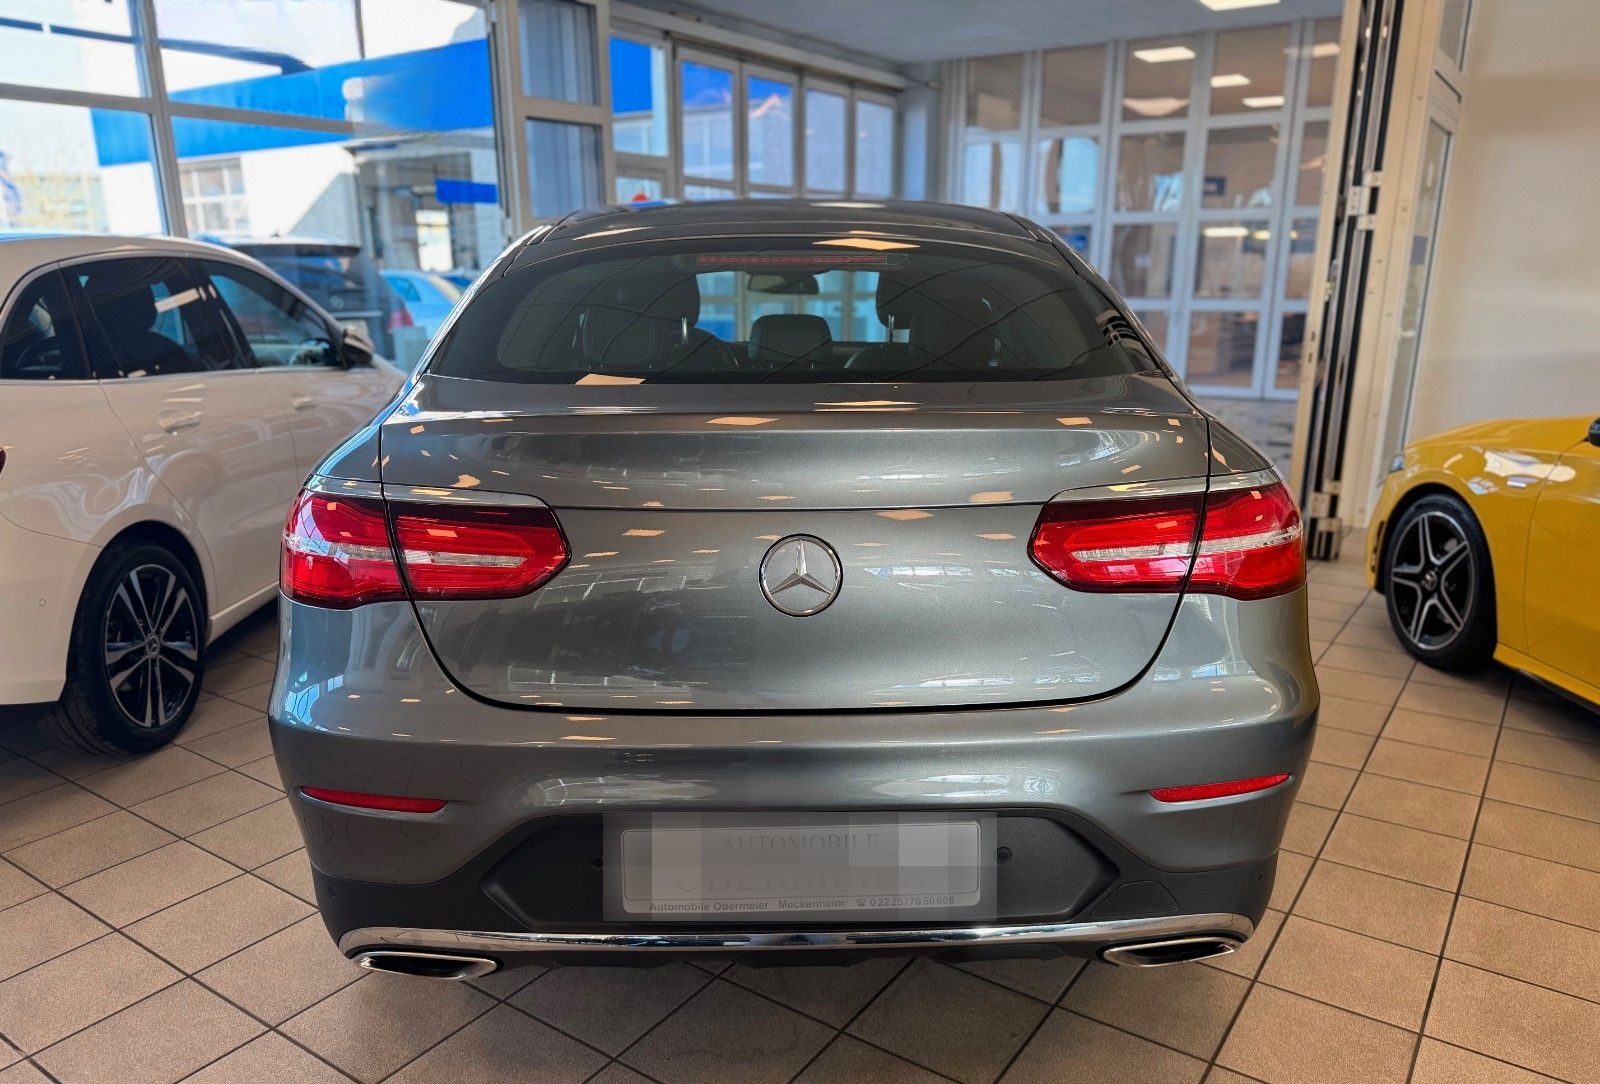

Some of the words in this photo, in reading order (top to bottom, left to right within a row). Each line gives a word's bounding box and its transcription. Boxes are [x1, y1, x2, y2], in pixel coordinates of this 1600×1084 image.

[721, 833, 879, 854] AUTOMOBILE
[649, 902, 710, 911] Automobile
[713, 901, 769, 910] Obermeier
[778, 899, 845, 909] Meckenheim
